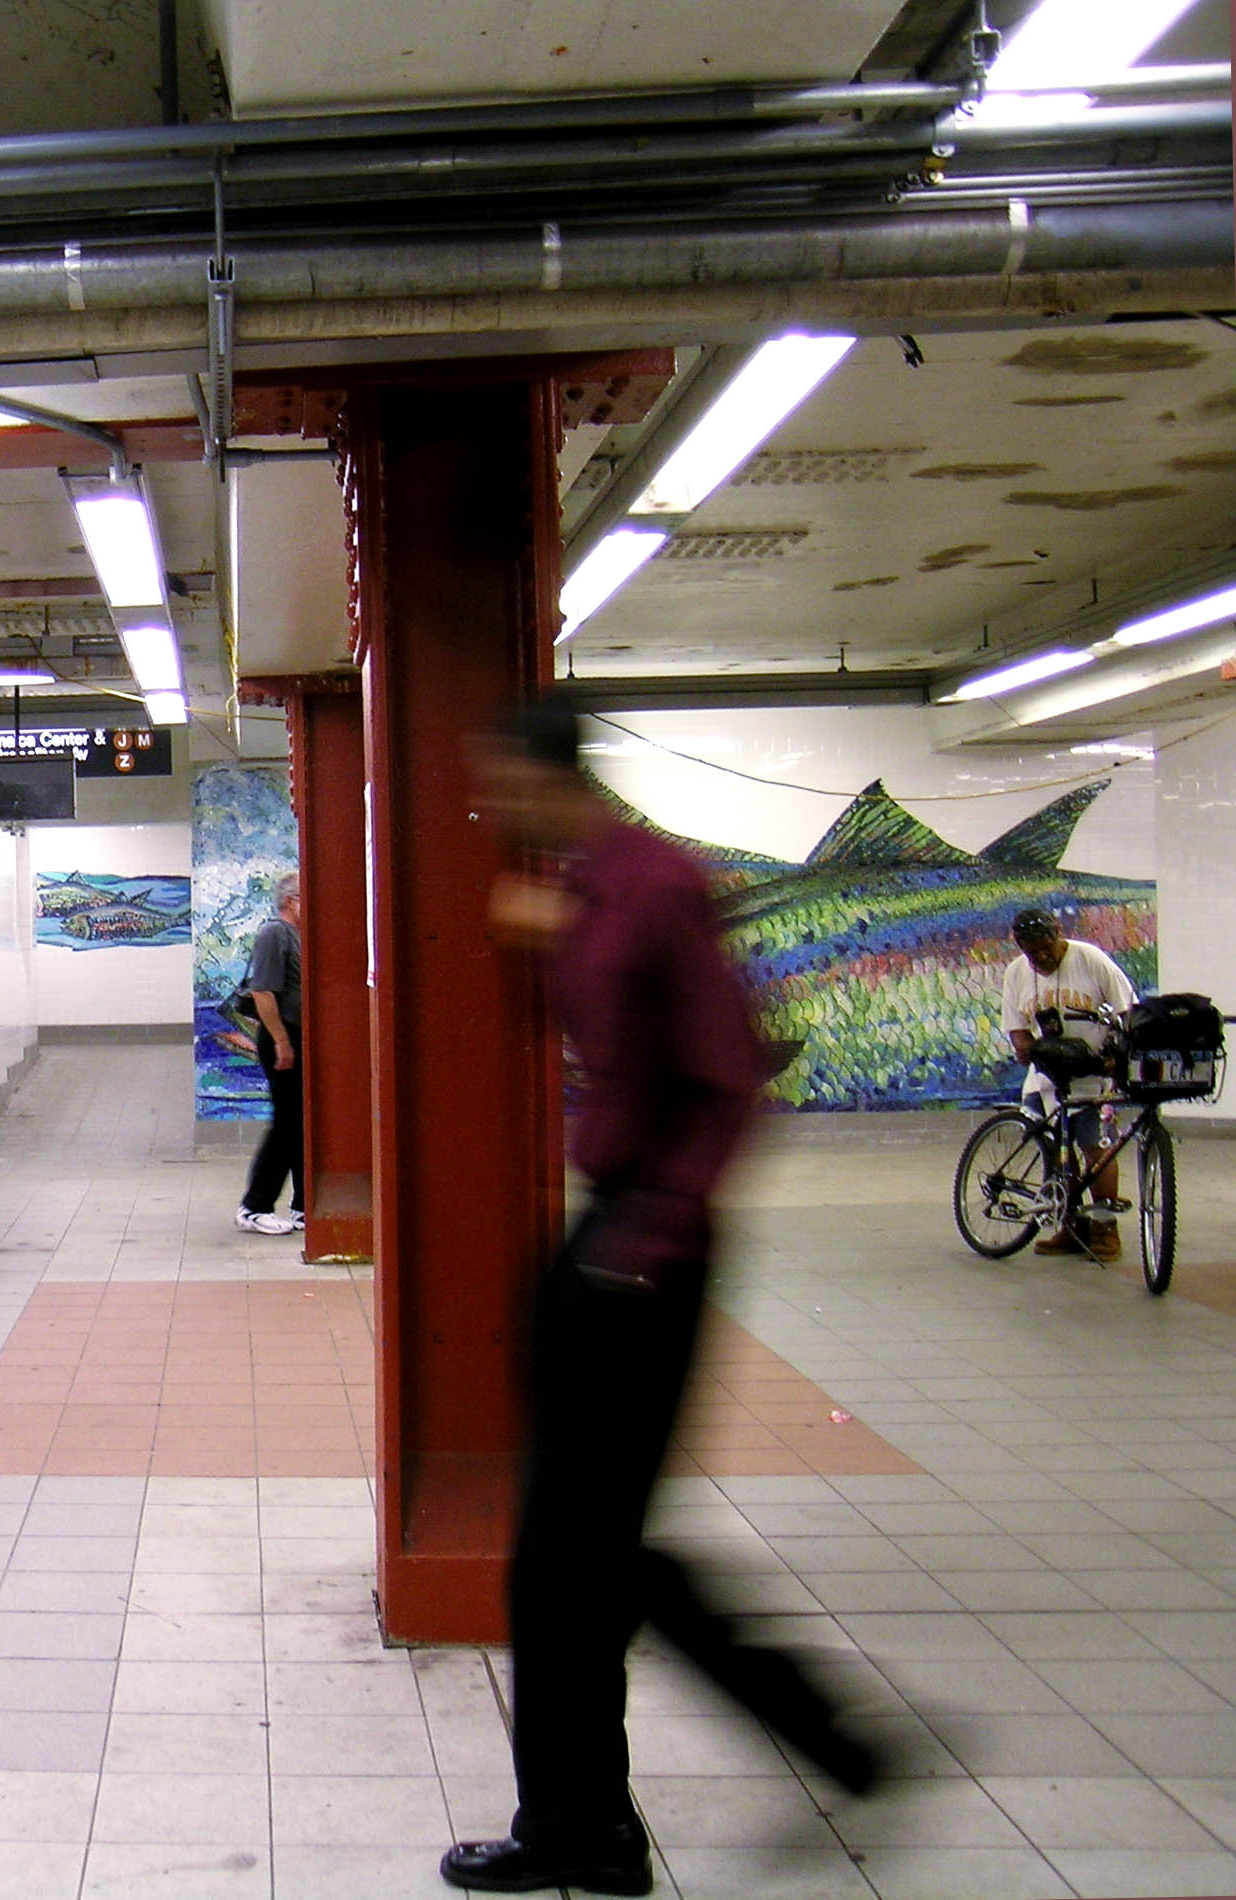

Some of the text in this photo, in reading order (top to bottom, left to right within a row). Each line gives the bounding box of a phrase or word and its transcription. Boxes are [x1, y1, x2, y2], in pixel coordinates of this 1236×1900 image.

[39, 731, 90, 748] Center
[93, 730, 106, 746] &
[117, 733, 151, 747] J M
[119, 755, 131, 768] Z
